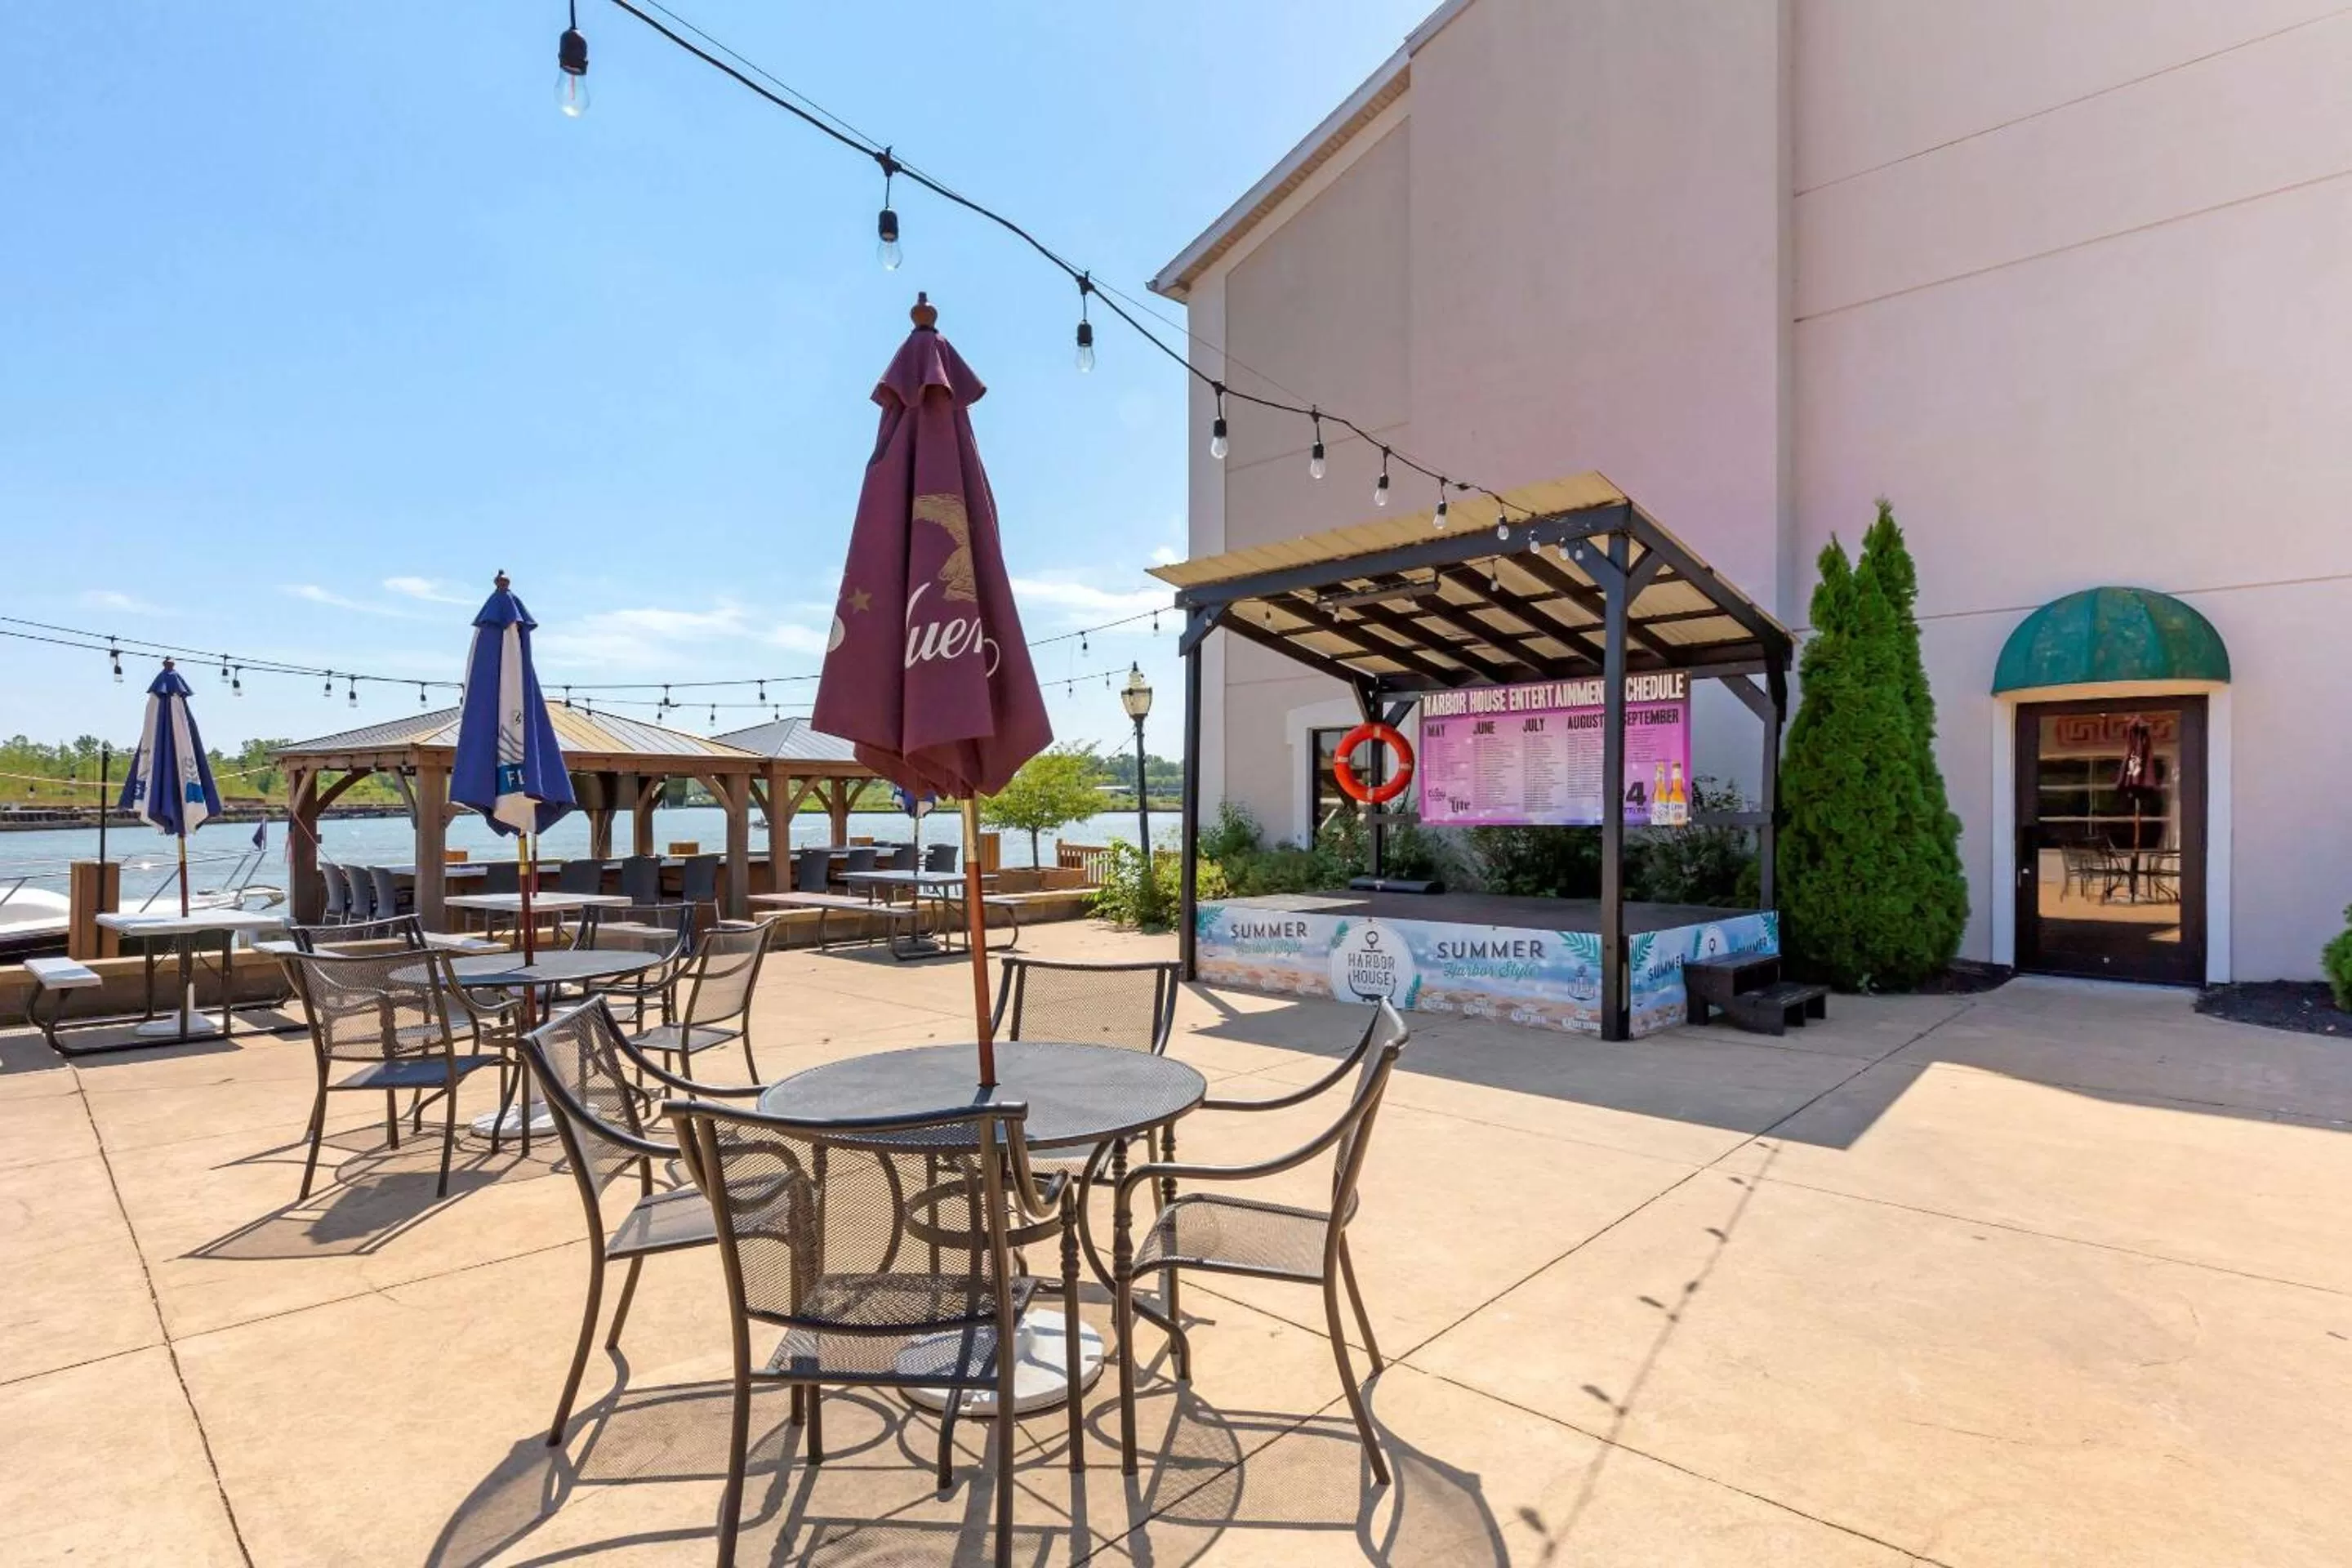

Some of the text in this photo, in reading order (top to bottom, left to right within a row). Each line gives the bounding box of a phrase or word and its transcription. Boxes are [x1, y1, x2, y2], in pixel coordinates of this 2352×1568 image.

[1423, 673, 1685, 717] HARBOR HOUSE ENTERTAINMEN CHEDULE
[1522, 718, 1544, 733] JULY
[1567, 714, 1605, 730] AUGUST
[1625, 708, 1679, 726] EPTEMBER
[1427, 724, 1445, 737] MAY
[1473, 721, 1495, 734] JUNE
[1626, 782, 1646, 806] 4
[1231, 921, 1307, 939] SUMMER
[1437, 940, 1546, 959] SUMMER
[1348, 953, 1395, 970] HARBOR
[1352, 969, 1390, 986] HOUSE
